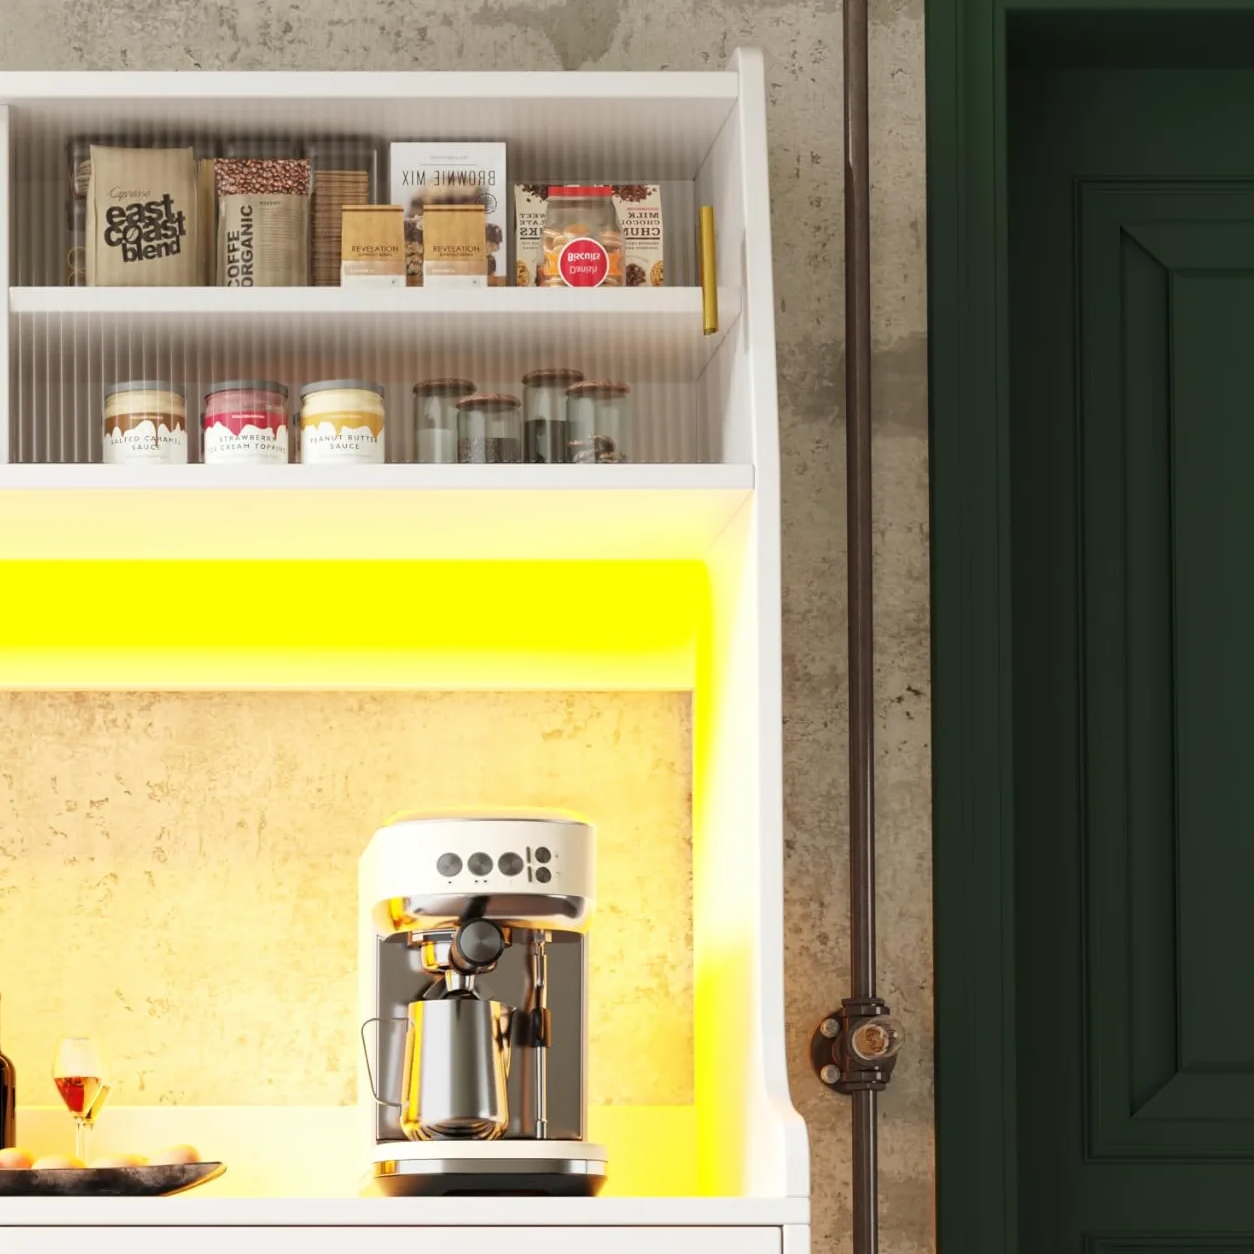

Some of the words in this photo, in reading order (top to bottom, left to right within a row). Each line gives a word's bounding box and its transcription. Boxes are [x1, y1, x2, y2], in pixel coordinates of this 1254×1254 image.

[106, 193, 175, 226] east
[104, 210, 186, 247] coast
[122, 235, 181, 263] blend
[240, 204, 254, 287] ORGANIC
[351, 245, 399, 253] REVELATION
[432, 245, 480, 253] REVELATION
